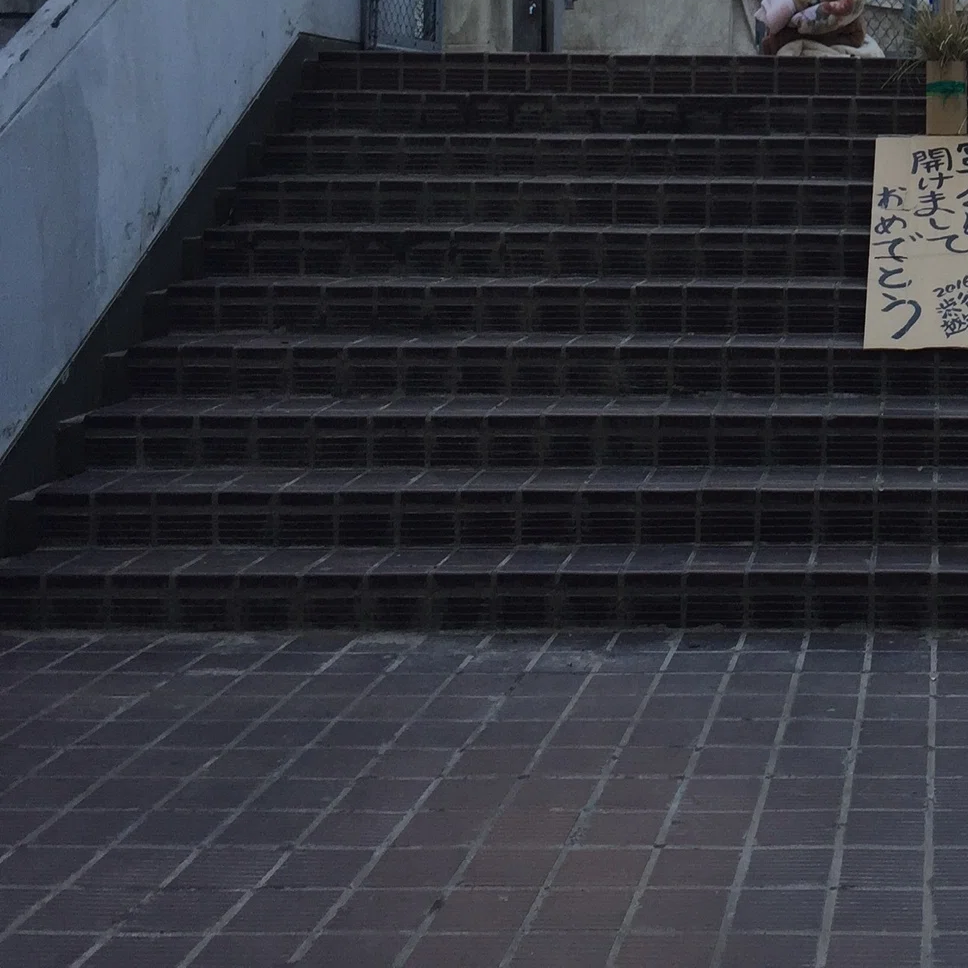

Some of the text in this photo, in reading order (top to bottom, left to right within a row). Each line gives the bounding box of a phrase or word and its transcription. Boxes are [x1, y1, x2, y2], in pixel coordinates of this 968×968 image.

[872, 186, 924, 340] おめでとう
